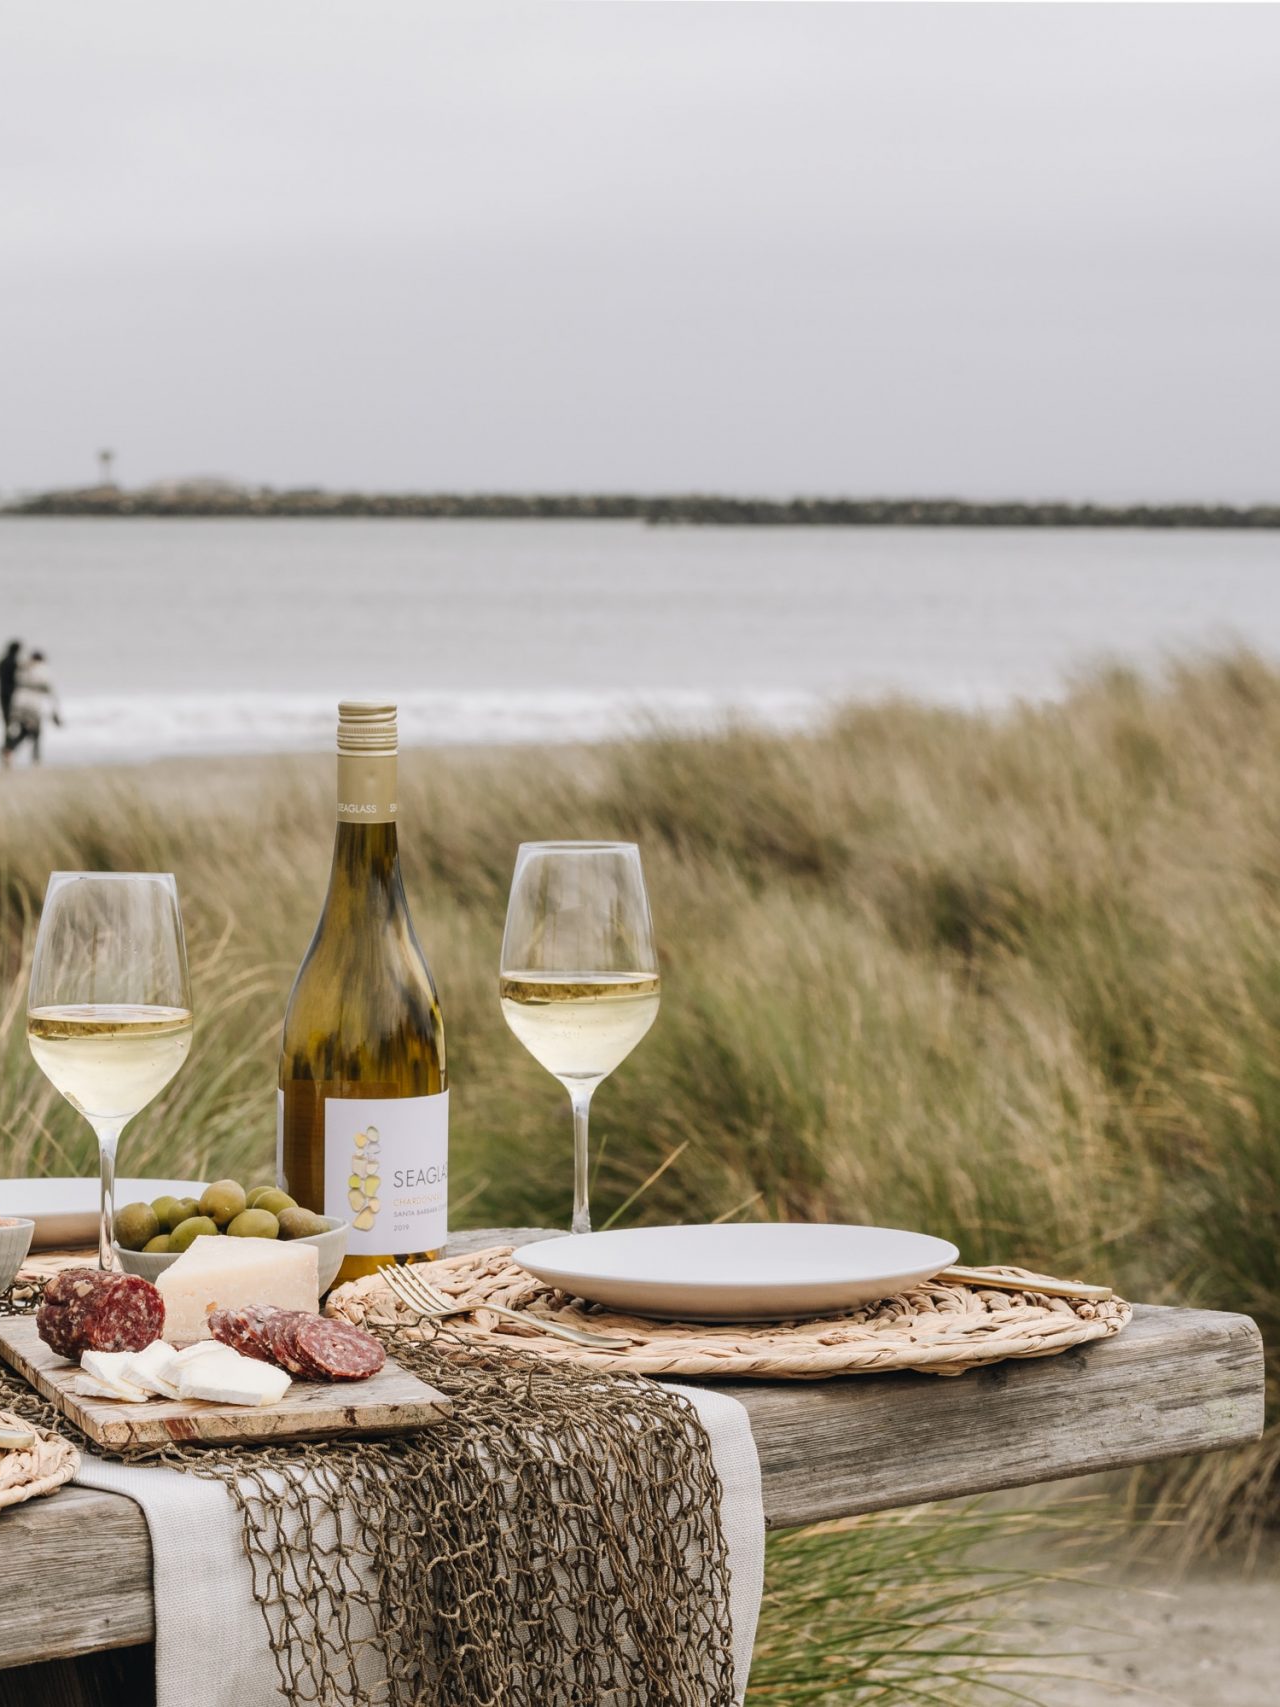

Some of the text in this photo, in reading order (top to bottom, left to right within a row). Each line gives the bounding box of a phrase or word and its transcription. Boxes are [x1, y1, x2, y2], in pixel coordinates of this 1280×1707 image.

[337, 803, 377, 813] EAGLASS
[393, 1164, 447, 1188] SEAGLA
[393, 1209, 415, 1218] SANTA
[393, 1223, 410, 1232] 2019
